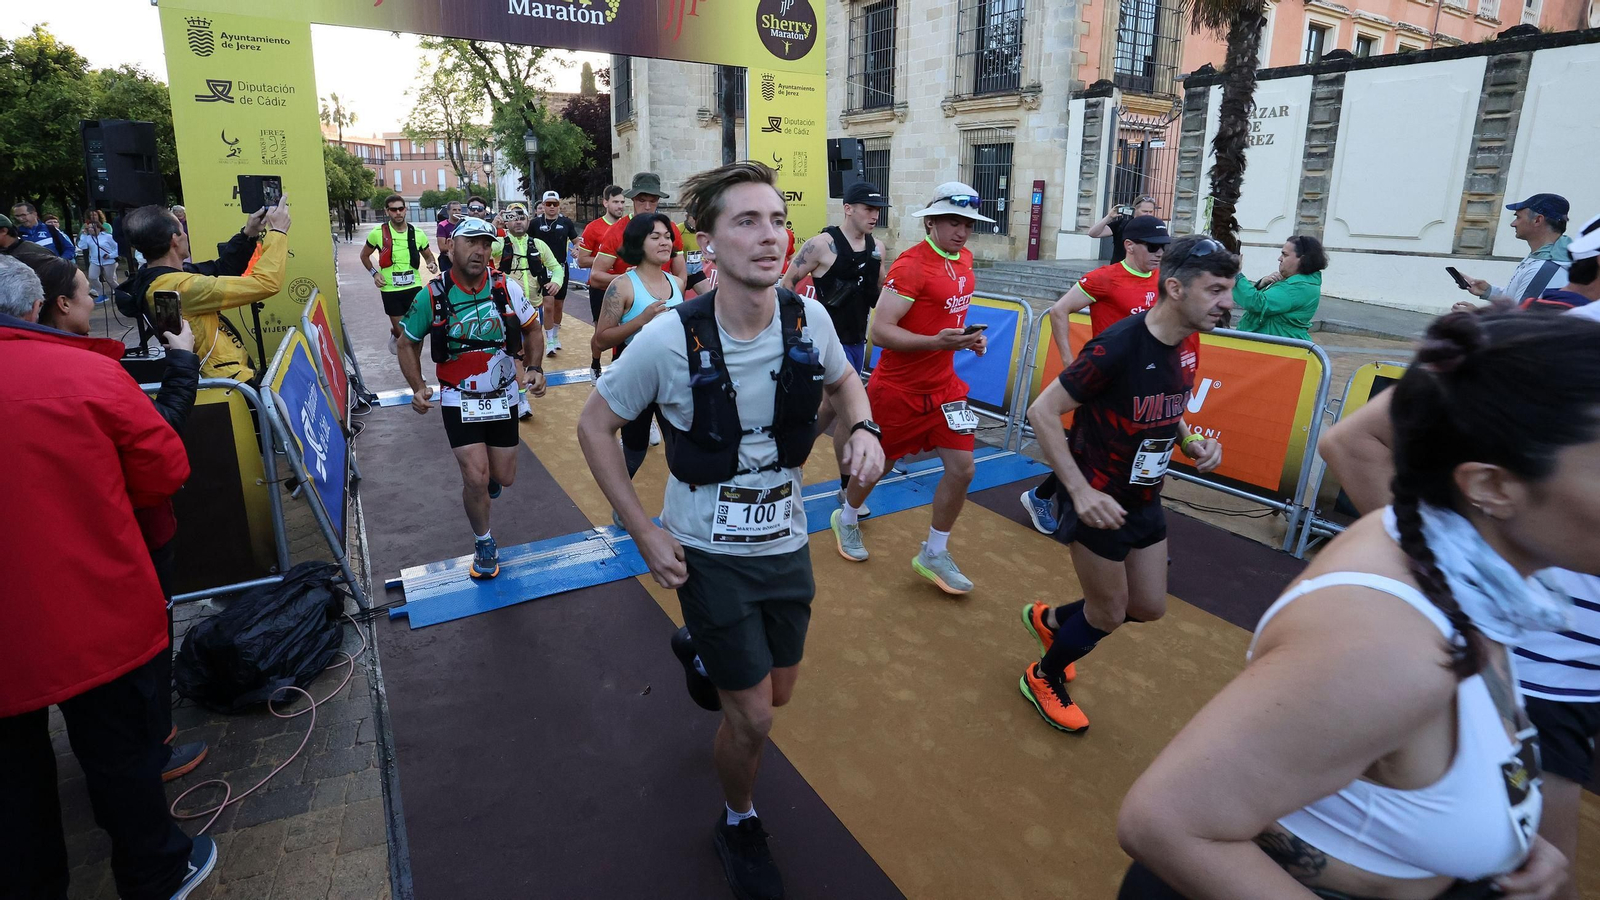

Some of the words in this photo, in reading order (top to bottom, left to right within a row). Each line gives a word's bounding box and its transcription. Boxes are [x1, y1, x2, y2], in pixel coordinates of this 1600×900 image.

[507, 0, 605, 25] Maratón
[761, 14, 812, 38] Sherry
[220, 32, 291, 45] Ayuntamiento
[770, 29, 804, 40] Maratón
[236, 42, 262, 51] Jerez
[238, 81, 295, 95] Diputación
[778, 83, 815, 92] Ayuntamiento
[239, 95, 253, 105] de
[257, 96, 287, 107] Cádiz
[1249, 105, 1290, 119] AZAR
[784, 117, 816, 126] Diputación
[793, 127, 810, 136] Cádiz
[1247, 133, 1275, 146] REZ
[290, 279, 317, 294] VALDESPIN
[944, 293, 973, 309] Sherr
[478, 398, 492, 411] 56
[958, 410, 975, 421] 180
[743, 503, 776, 524] 100
